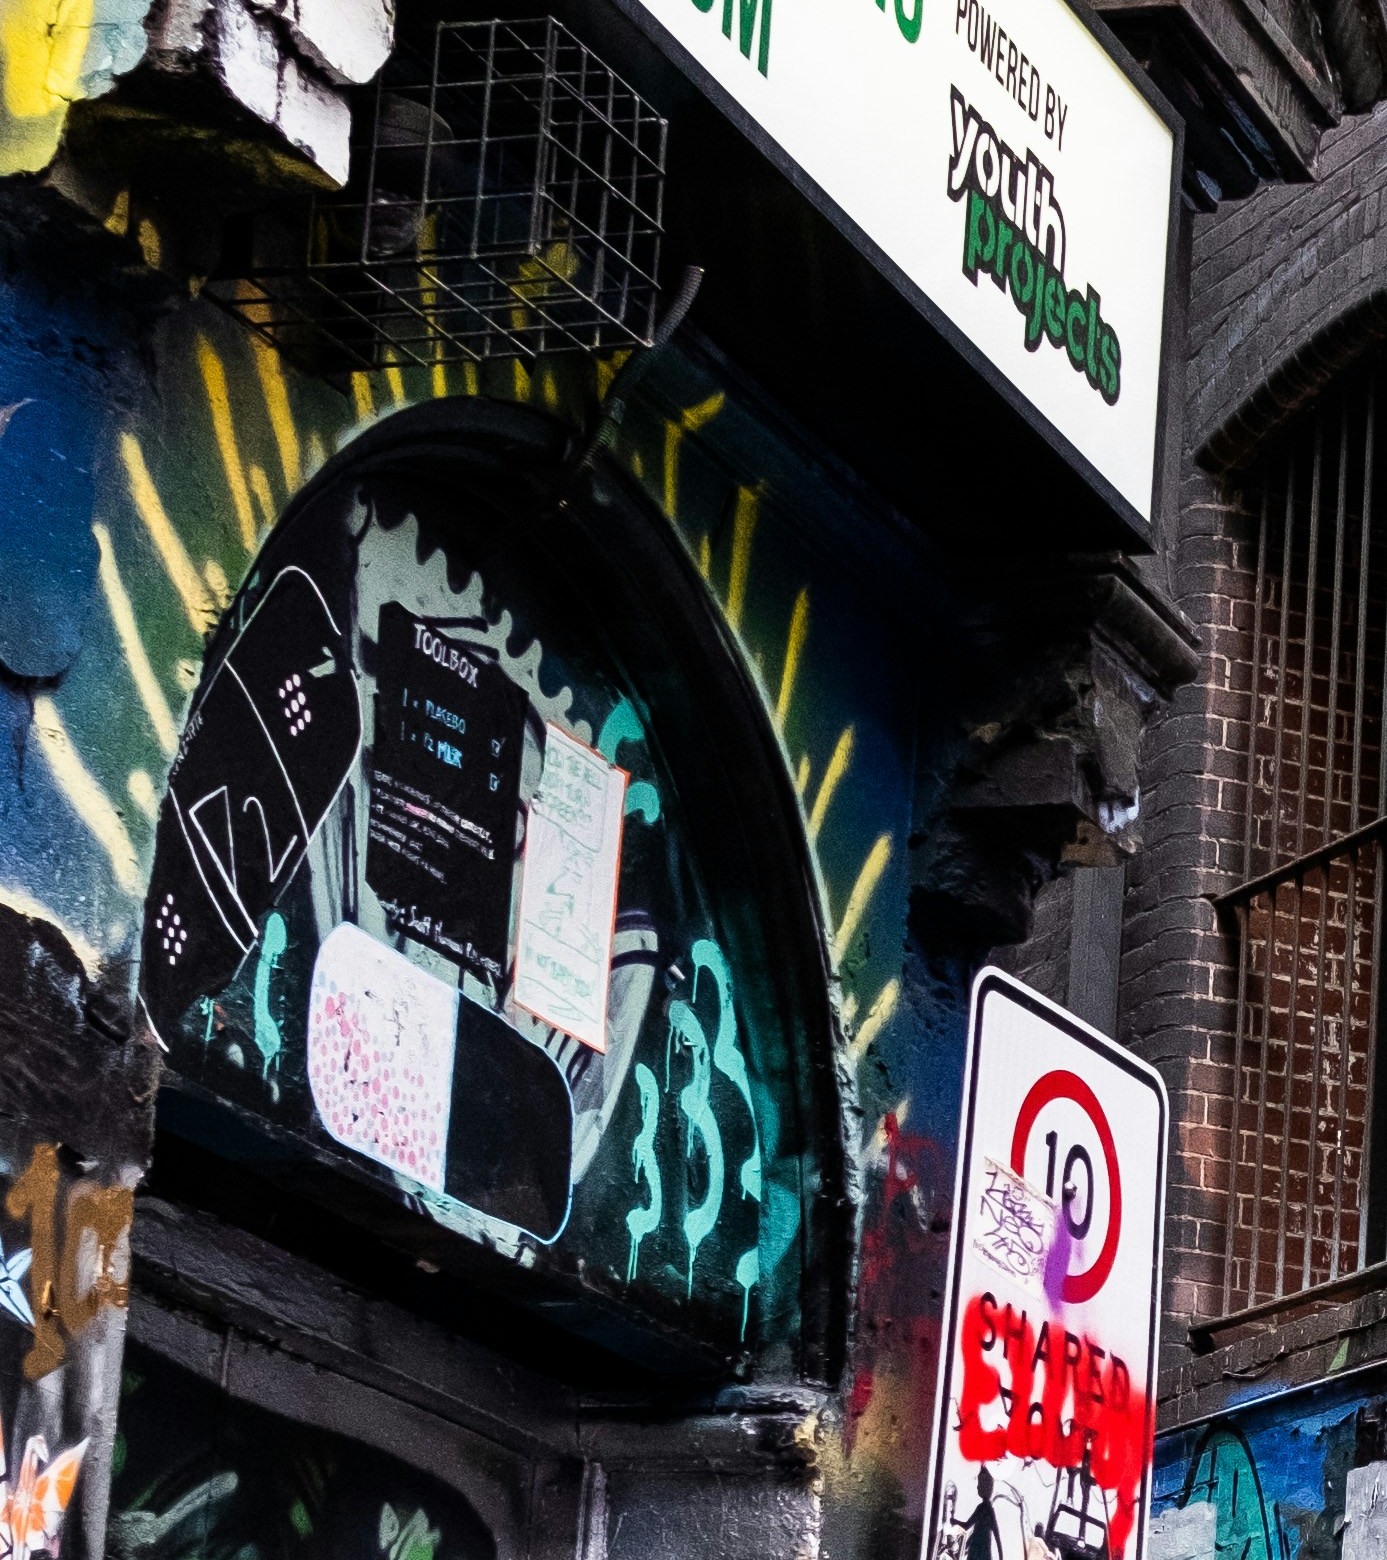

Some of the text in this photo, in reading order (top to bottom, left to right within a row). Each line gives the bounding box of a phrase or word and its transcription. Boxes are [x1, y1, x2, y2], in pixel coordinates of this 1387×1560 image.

[1040, 71, 1071, 154] BY
[947, 83, 1068, 283] youth
[961, 187, 1123, 406] projects
[413, 622, 480, 689] TOOLBOX
[1044, 1129, 1095, 1240] 10
[978, 1290, 1132, 1414] SHARED
